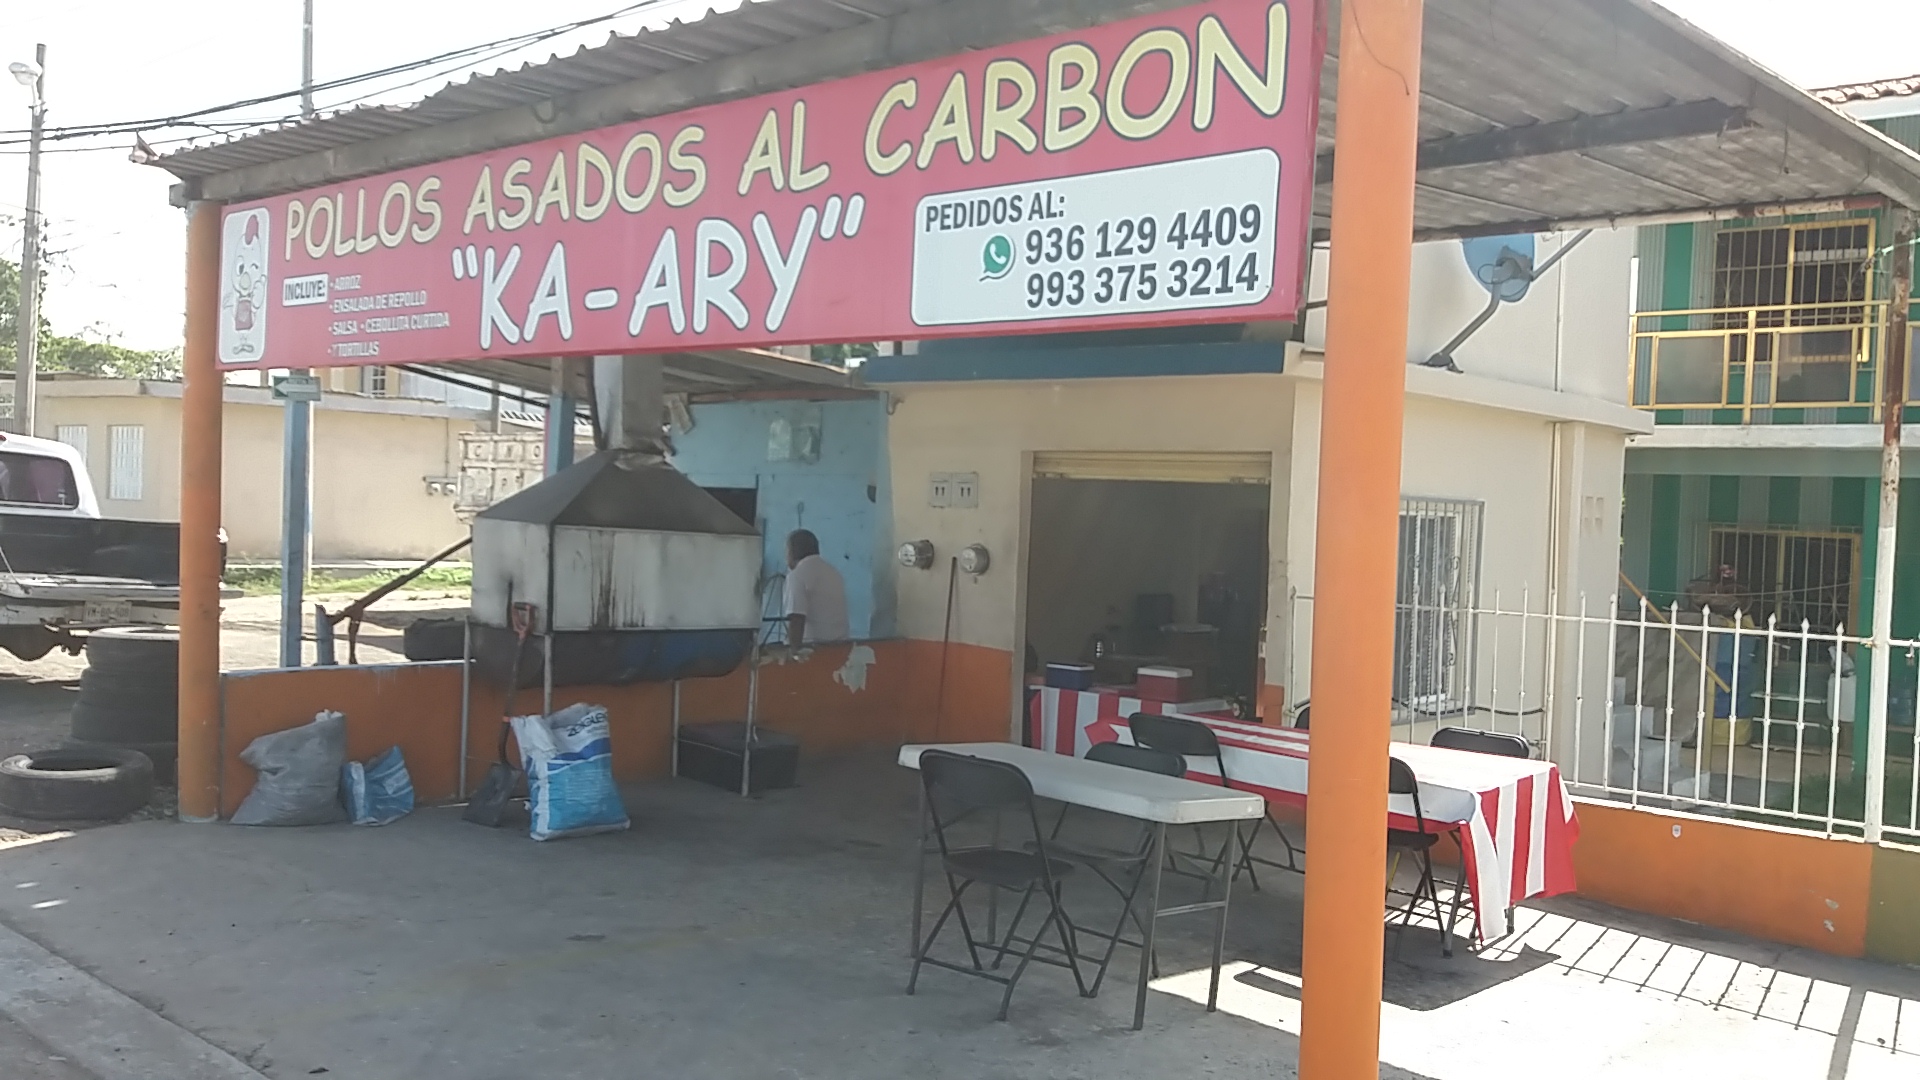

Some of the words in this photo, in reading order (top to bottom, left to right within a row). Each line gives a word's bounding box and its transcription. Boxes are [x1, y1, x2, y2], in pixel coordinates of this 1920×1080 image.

[284, 176, 442, 261] POLLOS
[463, 125, 707, 236] ASADOS
[738, 99, 830, 197] AL
[864, 1, 1289, 176] CARBON
[925, 194, 1023, 232] PEDIDOS
[1028, 191, 1066, 221] AL:
[1026, 226, 1085, 265] 936
[1095, 217, 1157, 259] 129
[1167, 204, 1261, 250] 4409
[285, 280, 325, 301] INCLUYE:
[1026, 269, 1085, 308] 993
[1094, 263, 1158, 303] 375
[1167, 253, 1259, 297] 3214
[331, 320, 358, 335] SALSA
